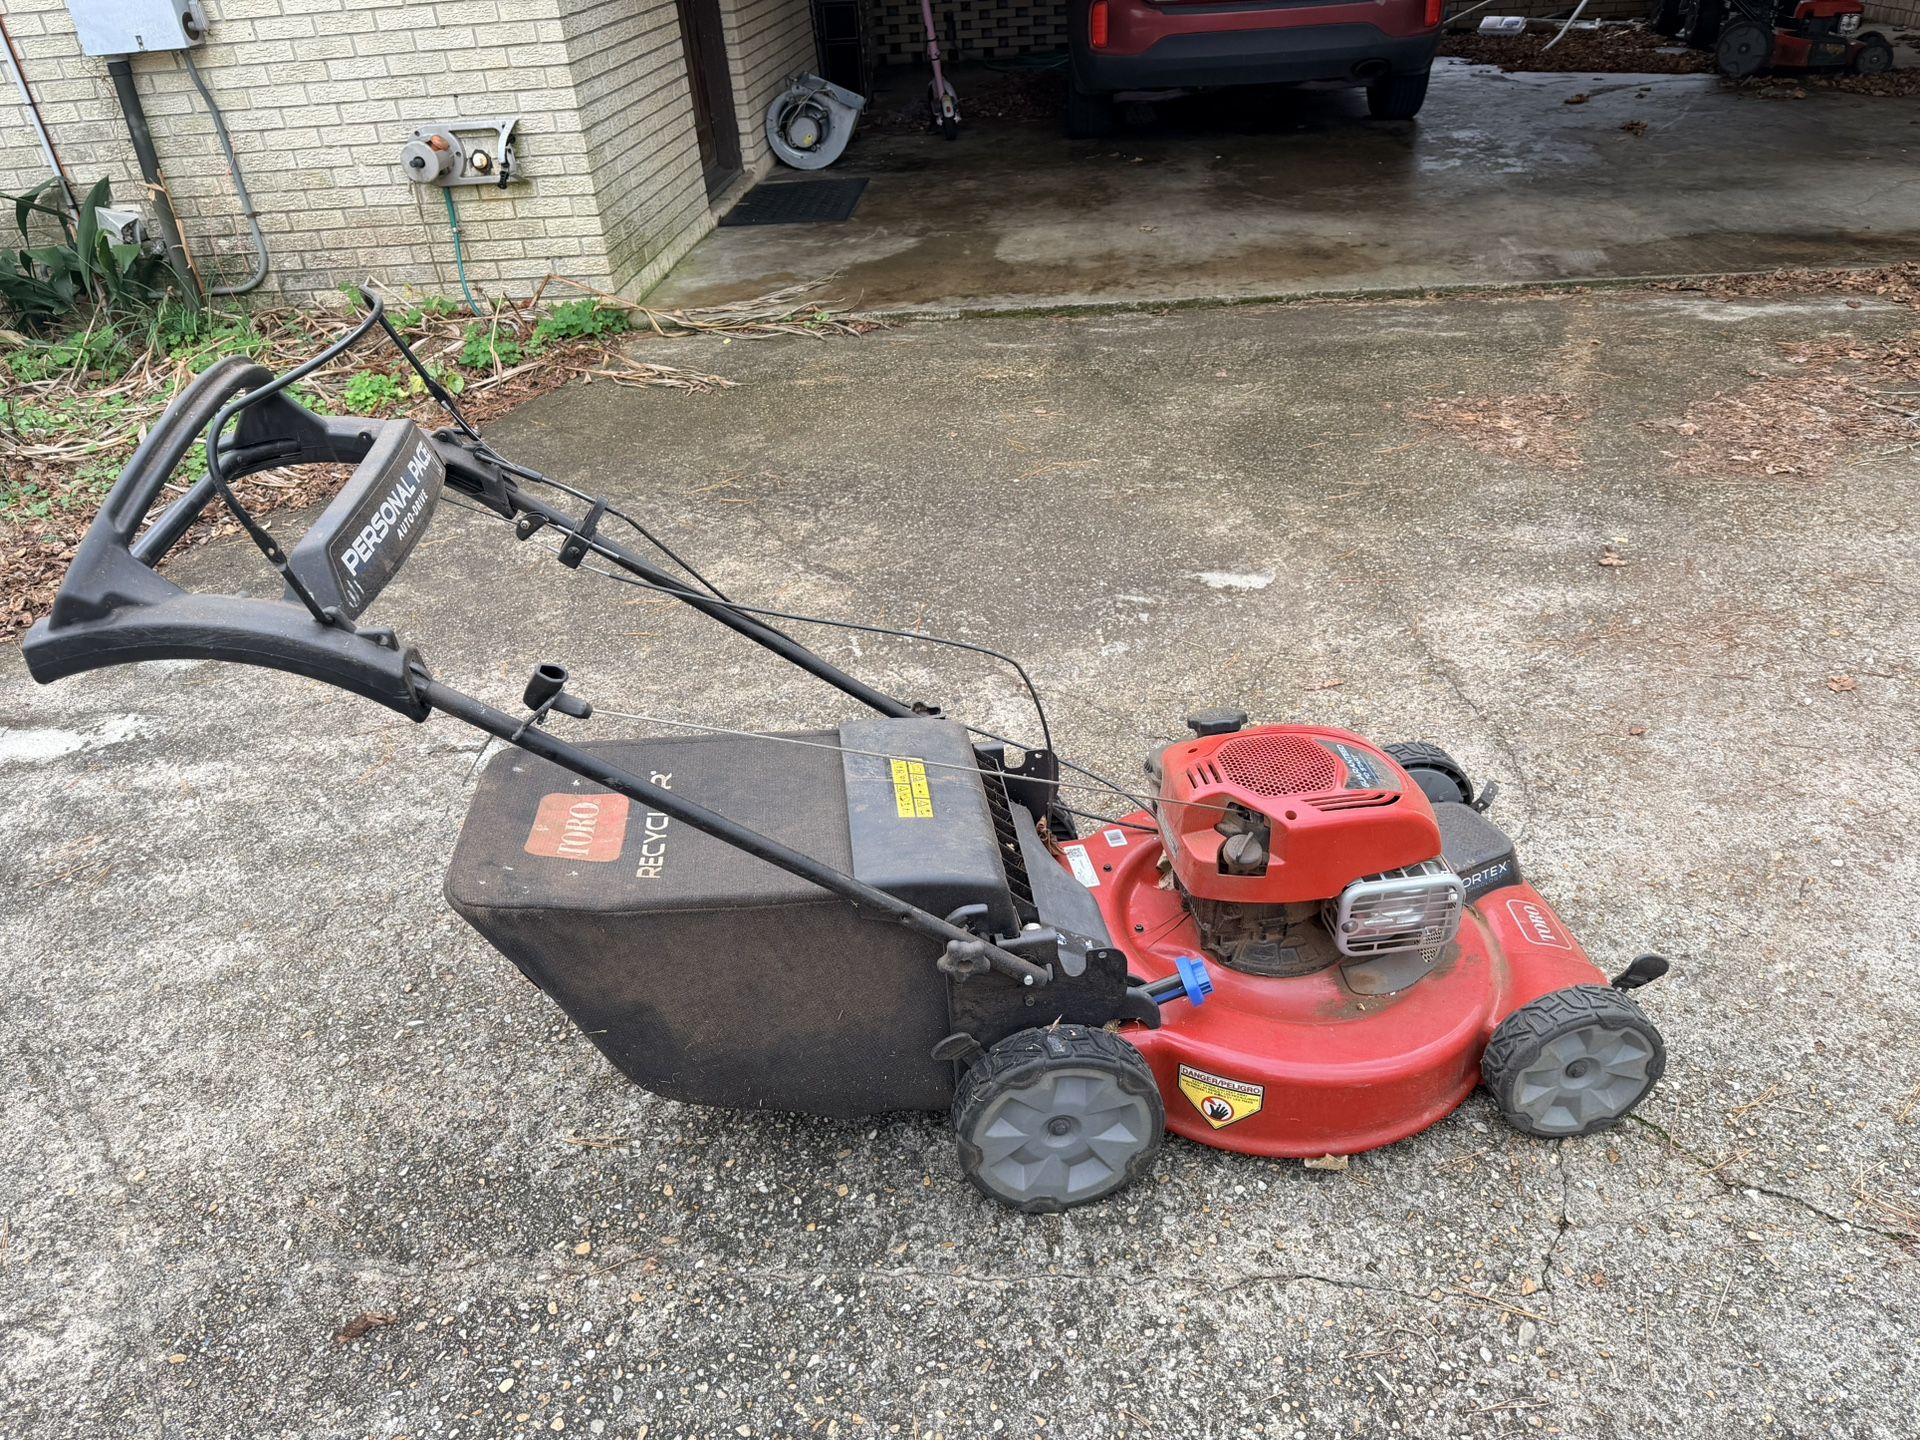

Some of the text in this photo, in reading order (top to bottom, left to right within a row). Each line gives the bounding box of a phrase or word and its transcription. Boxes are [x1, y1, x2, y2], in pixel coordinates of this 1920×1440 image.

[341, 441, 431, 576] PERSONAL PACE
[396, 489, 429, 541] AUTO-DRIVE
[556, 802, 600, 856] TORO
[636, 773, 672, 879] RECYCLR
[1462, 861, 1508, 888] ORTEX
[1523, 905, 1557, 941] TORO
[1182, 1067, 1260, 1094] DANGER/PELIGRO
